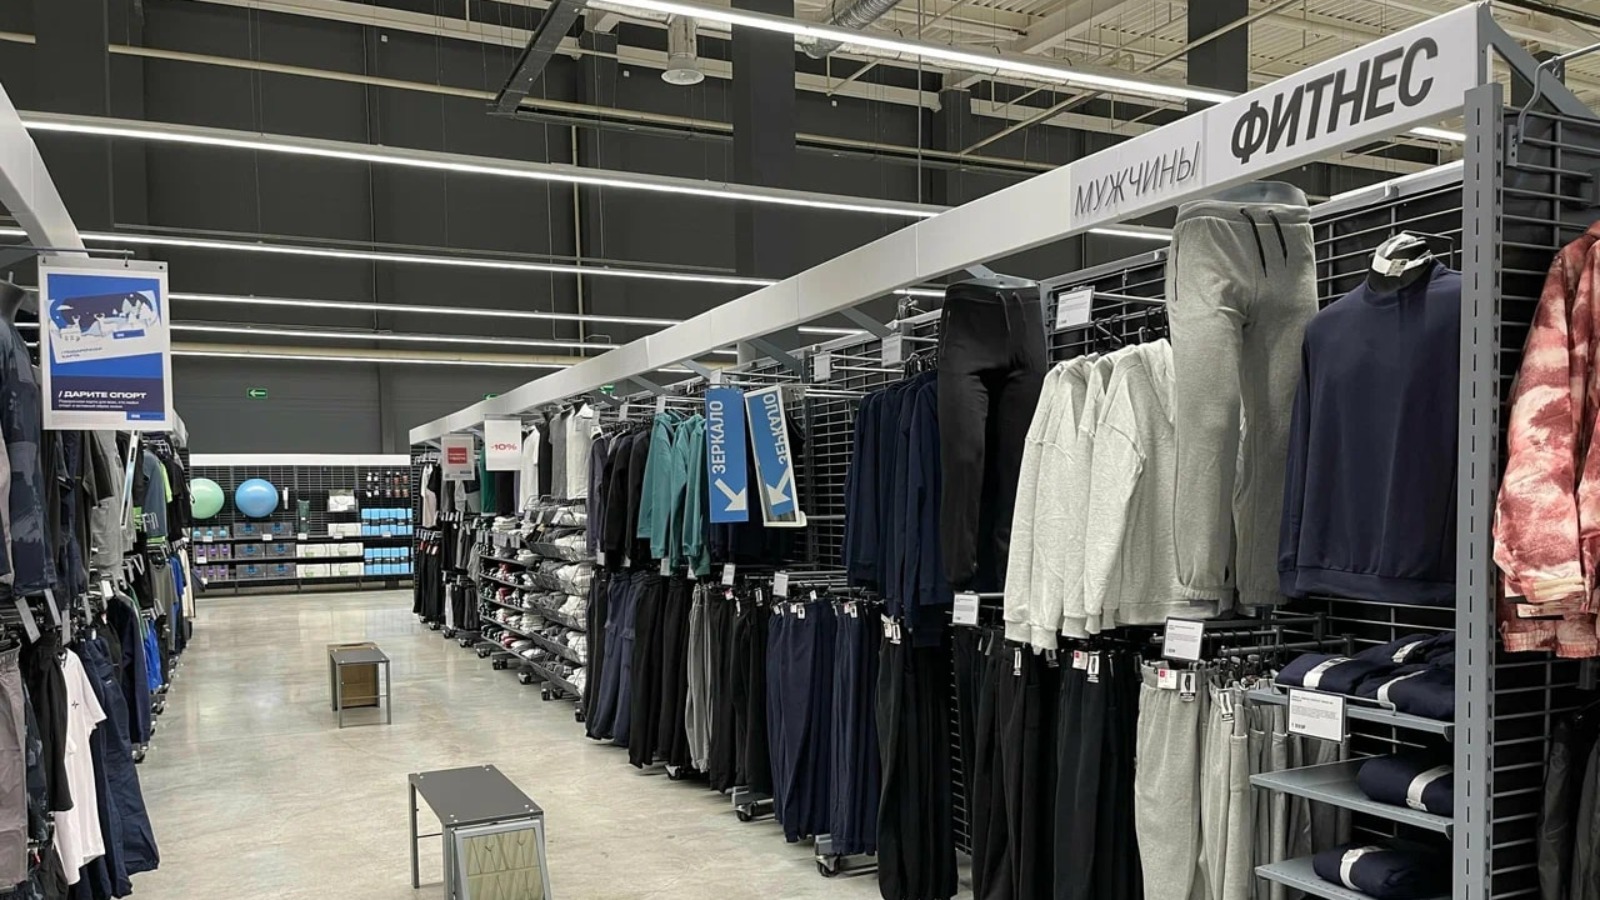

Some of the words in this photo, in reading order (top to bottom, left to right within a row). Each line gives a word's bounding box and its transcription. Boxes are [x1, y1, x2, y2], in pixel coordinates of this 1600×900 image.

[1231, 36, 1439, 165] ФИТНЕС
[1074, 141, 1200, 216] МУЖЧИНЫ
[64, 390, 108, 398] ДАРИТЕ
[109, 391, 147, 399] СПОРТ
[491, 443, 517, 451] -10%
[709, 400, 726, 474] ЗЕРКАЛО
